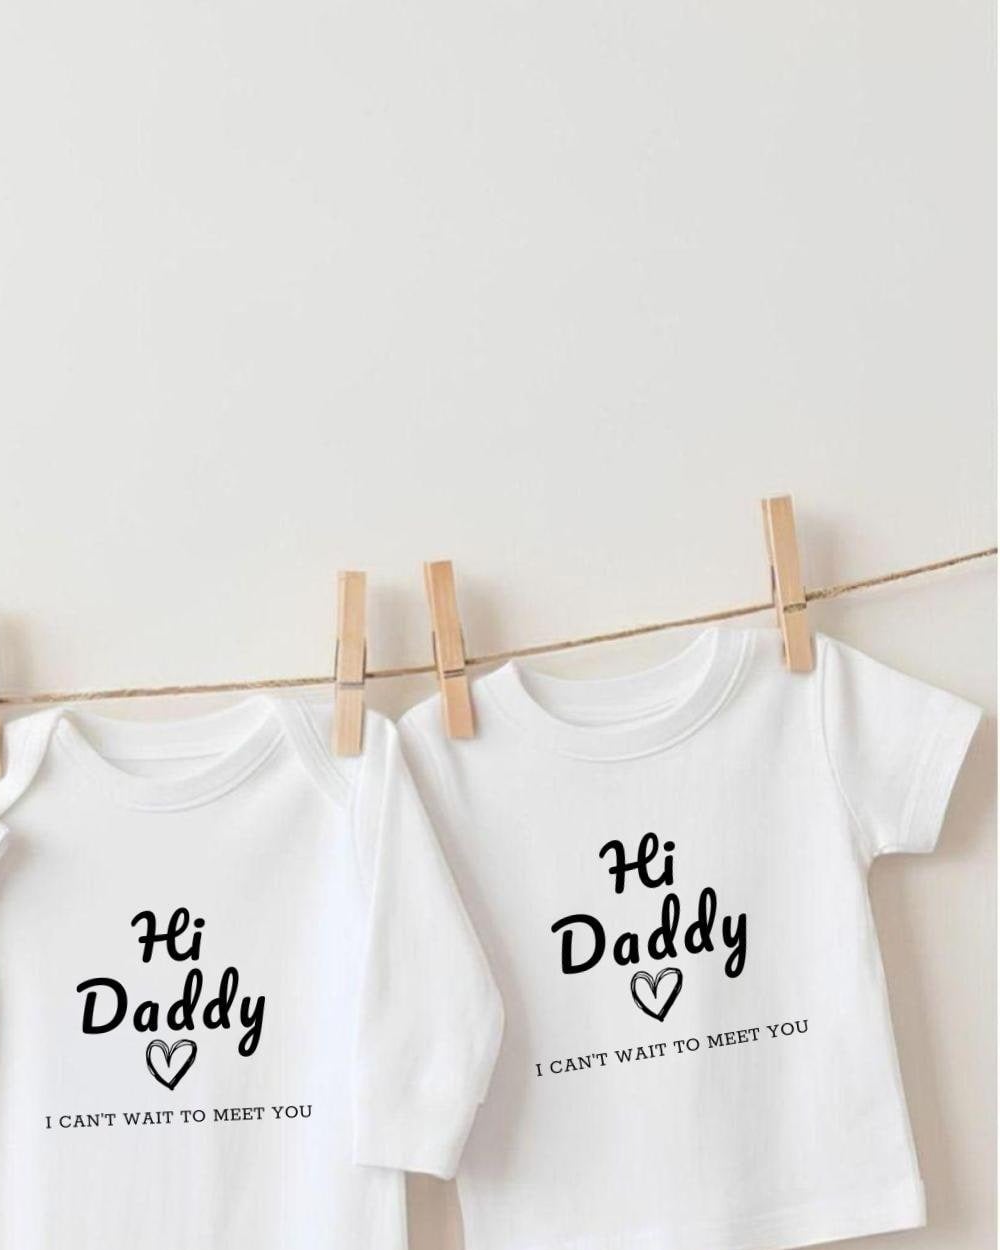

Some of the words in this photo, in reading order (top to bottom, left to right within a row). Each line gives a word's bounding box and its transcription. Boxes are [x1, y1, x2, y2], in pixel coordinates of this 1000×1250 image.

[598, 831, 676, 895] Hi
[130, 906, 206, 964] Hi
[550, 886, 747, 979] Daddy
[76, 966, 266, 1058] Daddy
[535, 1063, 543, 1077] I
[549, 1052, 608, 1074] CAN'T
[614, 1042, 667, 1064] WAIT
[672, 1037, 700, 1054] TO
[706, 1027, 760, 1049] MEET
[766, 1019, 808, 1038] YOU
[45, 1115, 52, 1129] I
[59, 1112, 117, 1129] CAN'T
[122, 1110, 174, 1126] WAIT
[179, 1109, 206, 1124] TO
[213, 1106, 265, 1122] MEET
[271, 1104, 312, 1120] YOU
